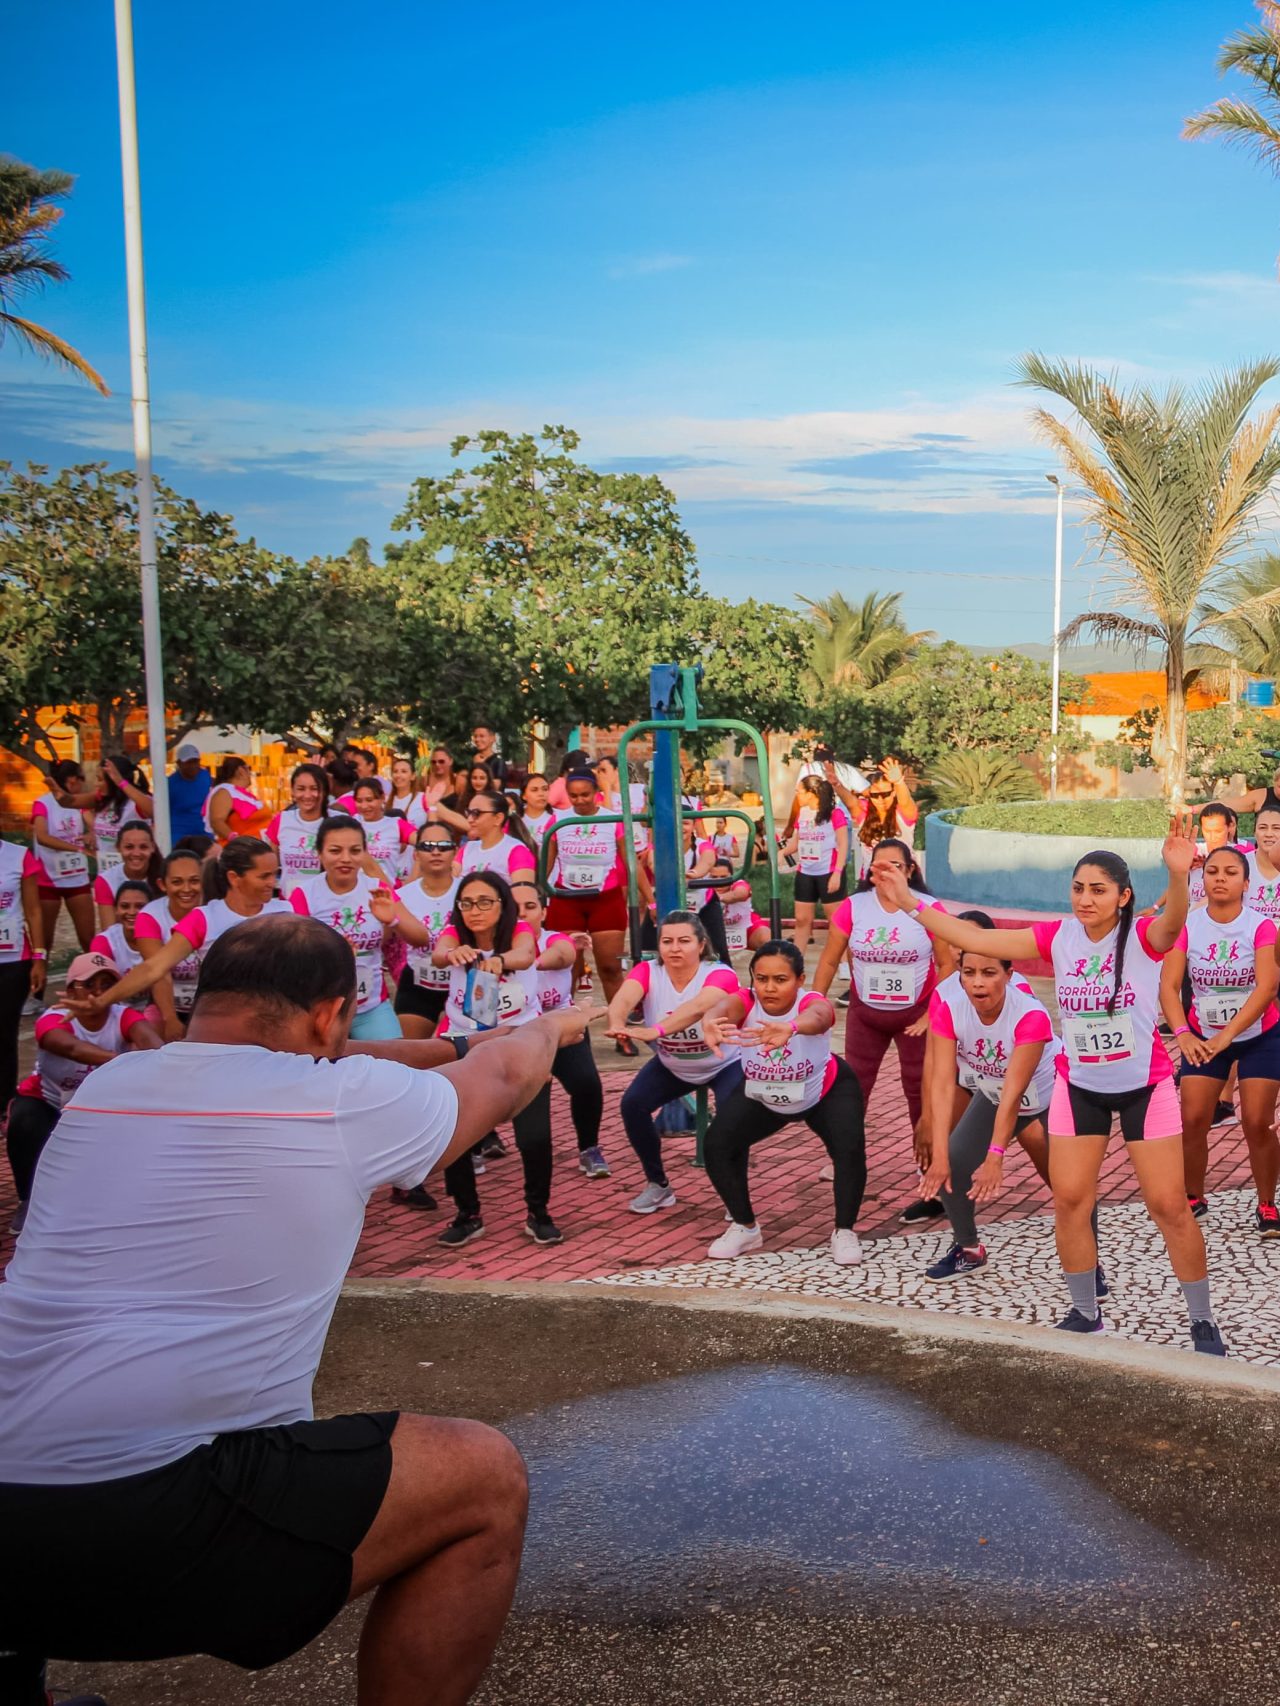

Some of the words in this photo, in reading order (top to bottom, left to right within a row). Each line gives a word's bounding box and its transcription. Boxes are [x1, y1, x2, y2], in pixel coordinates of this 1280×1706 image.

[561, 847, 608, 855] MULHER
[285, 860, 319, 869] MULH
[580, 873, 593, 883] 84
[902, 949, 918, 957] DA
[1192, 966, 1238, 977] CORRIDA
[1241, 966, 1255, 975] DA
[885, 979, 902, 992] 38
[1191, 975, 1256, 987] MULHER
[543, 987, 558, 999] DA
[1058, 985, 1110, 997] CORRIDA
[1058, 992, 1136, 1012] MULHER
[1220, 1007, 1243, 1022] 12
[1090, 1032, 1125, 1050] 132
[746, 1059, 794, 1074] CORRIDA
[797, 1058, 812, 1071] DA
[744, 1066, 814, 1081] MULHER
[771, 1095, 792, 1104] 28
